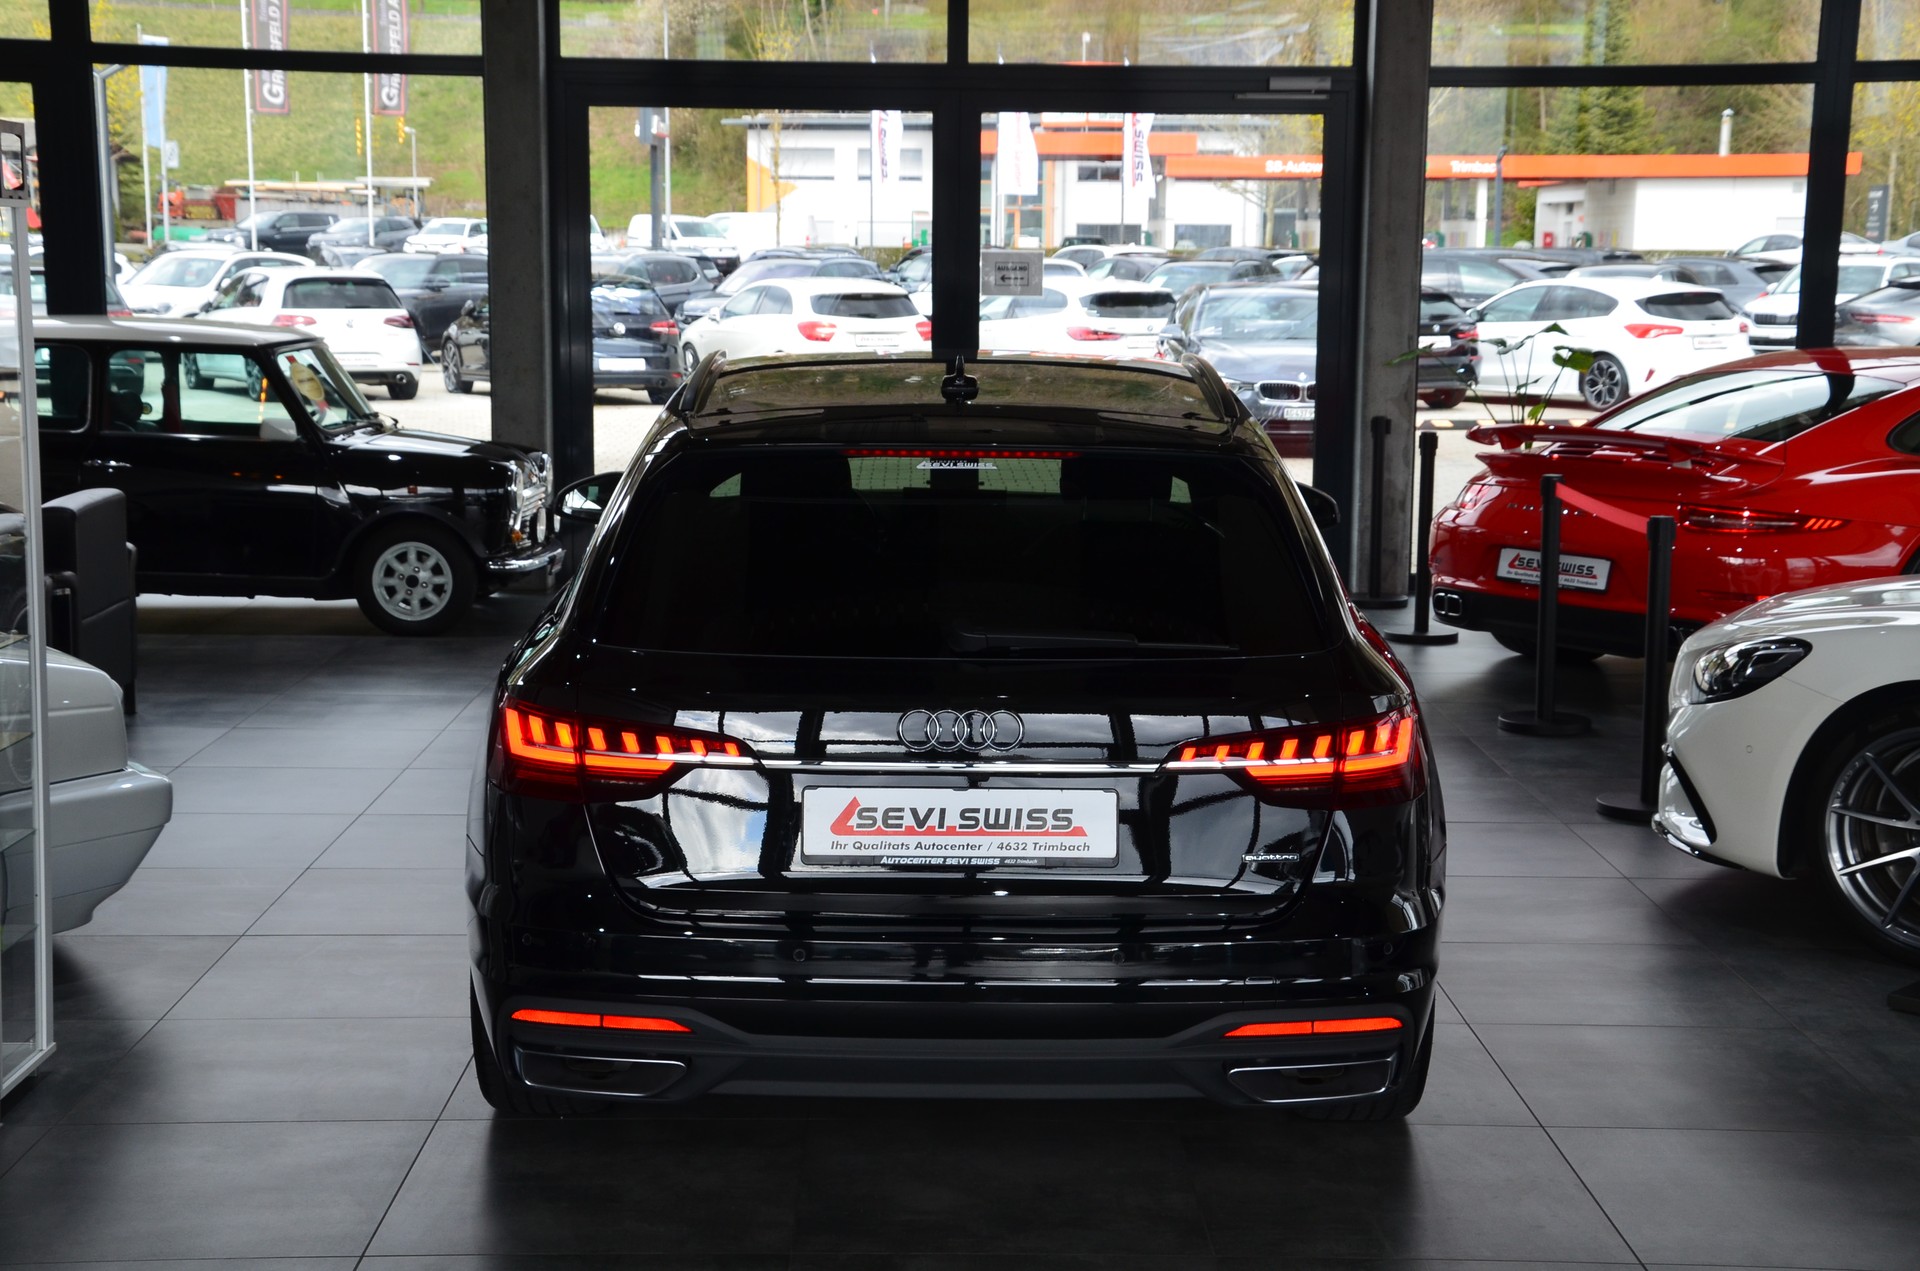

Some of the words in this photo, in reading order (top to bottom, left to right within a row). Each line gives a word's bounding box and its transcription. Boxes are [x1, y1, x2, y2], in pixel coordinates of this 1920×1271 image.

[1450, 160, 1497, 173] Trimbac
[1558, 561, 1595, 576] WISS
[855, 807, 947, 831] SEVI
[958, 807, 1073, 831] SWISS
[830, 841, 849, 850] Ihr
[853, 841, 911, 851] Qualitats
[914, 841, 983, 851] Autocenter
[997, 842, 1028, 851] 4632
[1032, 842, 1091, 852] Trimbach
[946, 857, 969, 865] SEVI
[970, 857, 1000, 865] SWISS
